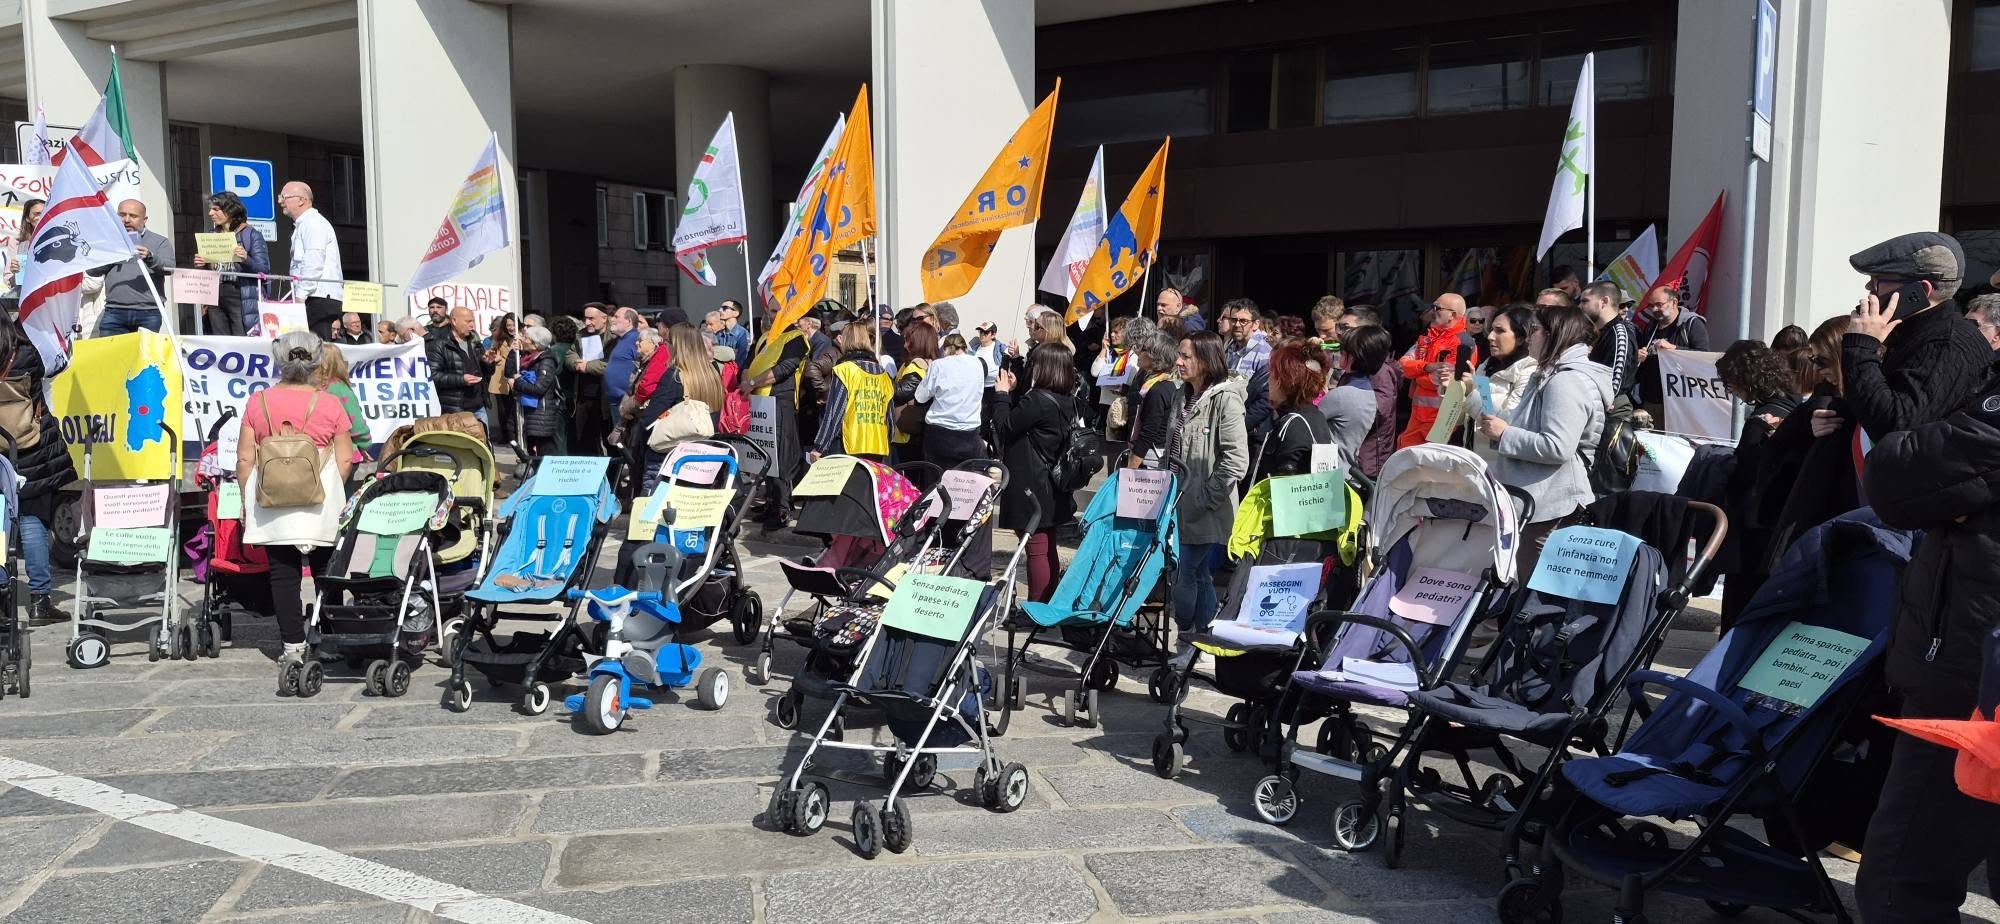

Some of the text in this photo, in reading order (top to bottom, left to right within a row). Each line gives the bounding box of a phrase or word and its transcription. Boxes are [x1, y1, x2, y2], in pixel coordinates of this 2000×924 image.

[224, 164, 260, 198] P
[413, 283, 512, 313] OSPEDALE
[1291, 482, 1323, 494] Infanzia
[1298, 496, 1325, 507] rischio
[1567, 534, 1618, 551] Senza cure,
[1557, 547, 1618, 566] l'infanzia non
[1546, 563, 1618, 582] nasce nemmeno
[912, 578, 970, 598] Senza pediatra,
[1259, 580, 1303, 588] PASSEGGINI
[1418, 576, 1472, 591] Dove sono
[911, 592, 960, 609] il paese si fa
[1414, 591, 1463, 605] pediatri?
[914, 606, 945, 619] deserto
[1791, 632, 1863, 658] Prima sparisce il
[1822, 657, 1842, 668] poi
[1840, 662, 1848, 670] i
[1778, 678, 1803, 689] paesi
[1810, 670, 1830, 682] poi
[1829, 675, 1837, 683] i
